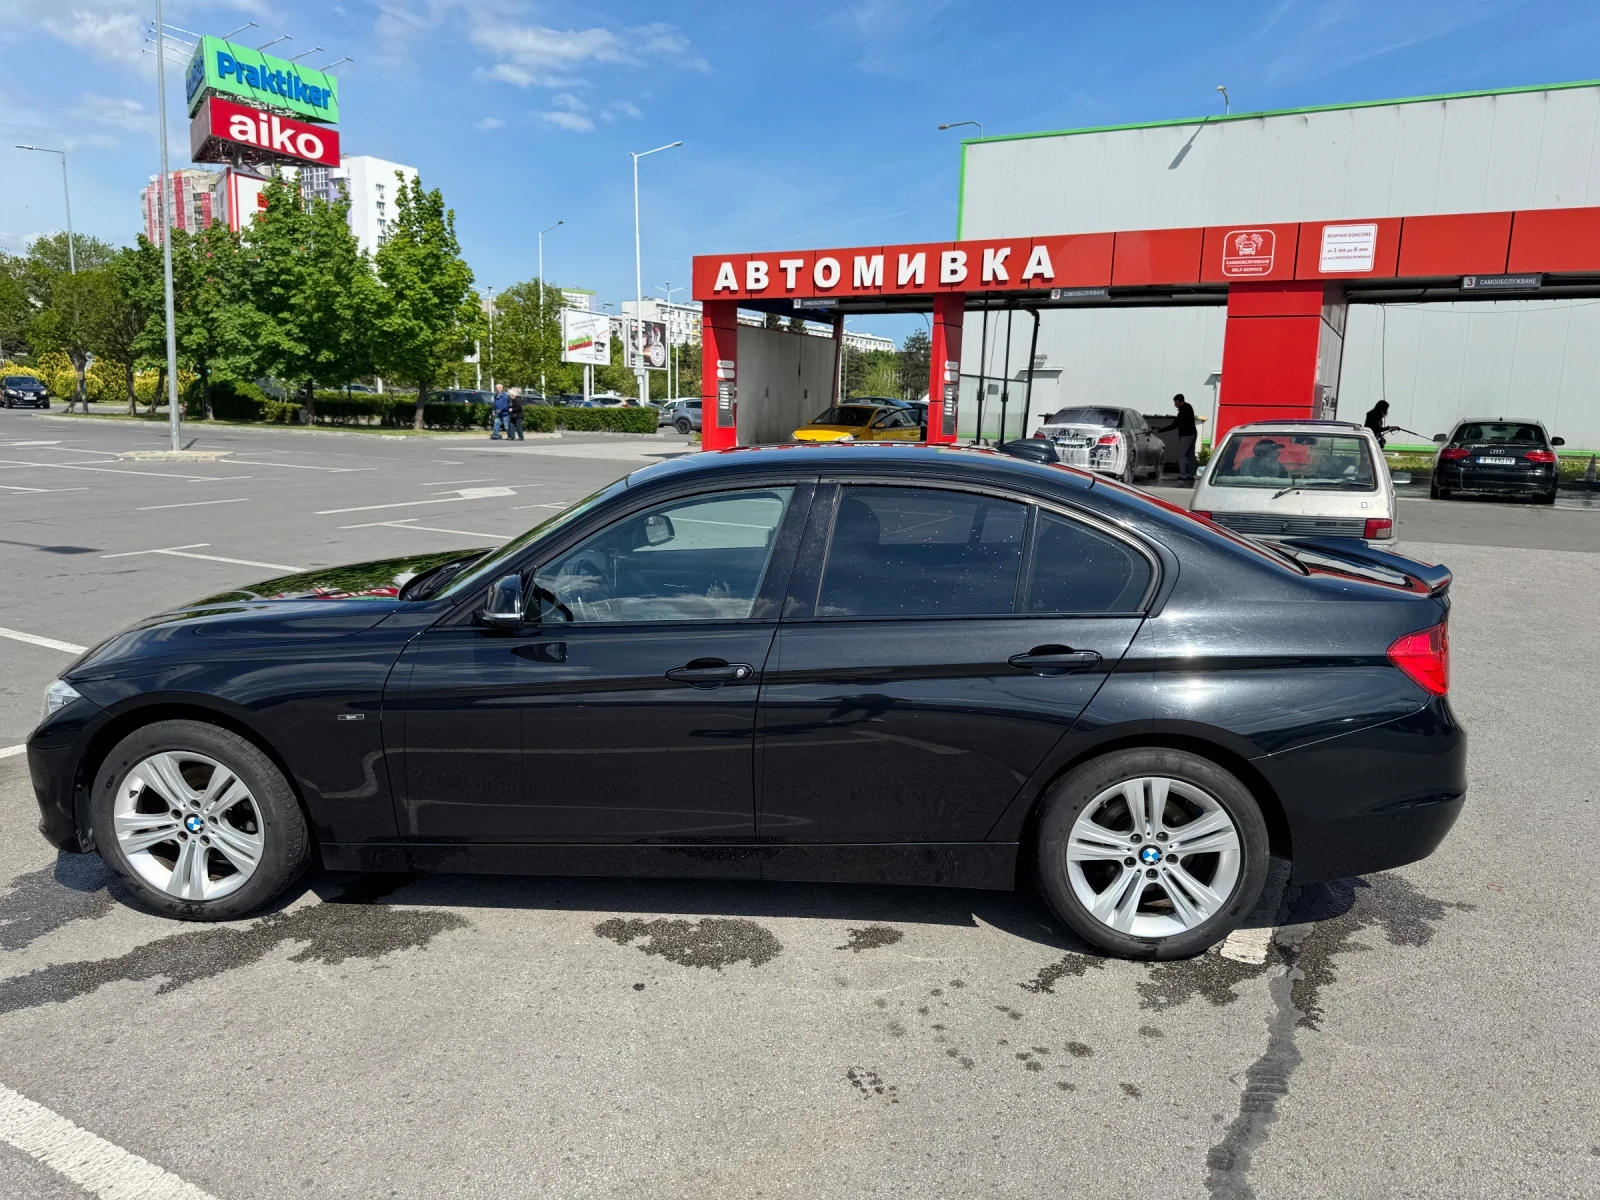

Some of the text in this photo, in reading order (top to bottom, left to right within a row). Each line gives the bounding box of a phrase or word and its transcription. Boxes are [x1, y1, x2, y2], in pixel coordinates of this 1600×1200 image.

[216, 50, 332, 110] Praktiker
[229, 112, 325, 160] aiko
[713, 245, 1056, 292] АВТОМИВКА
[1467, 278, 1473, 286] 3
